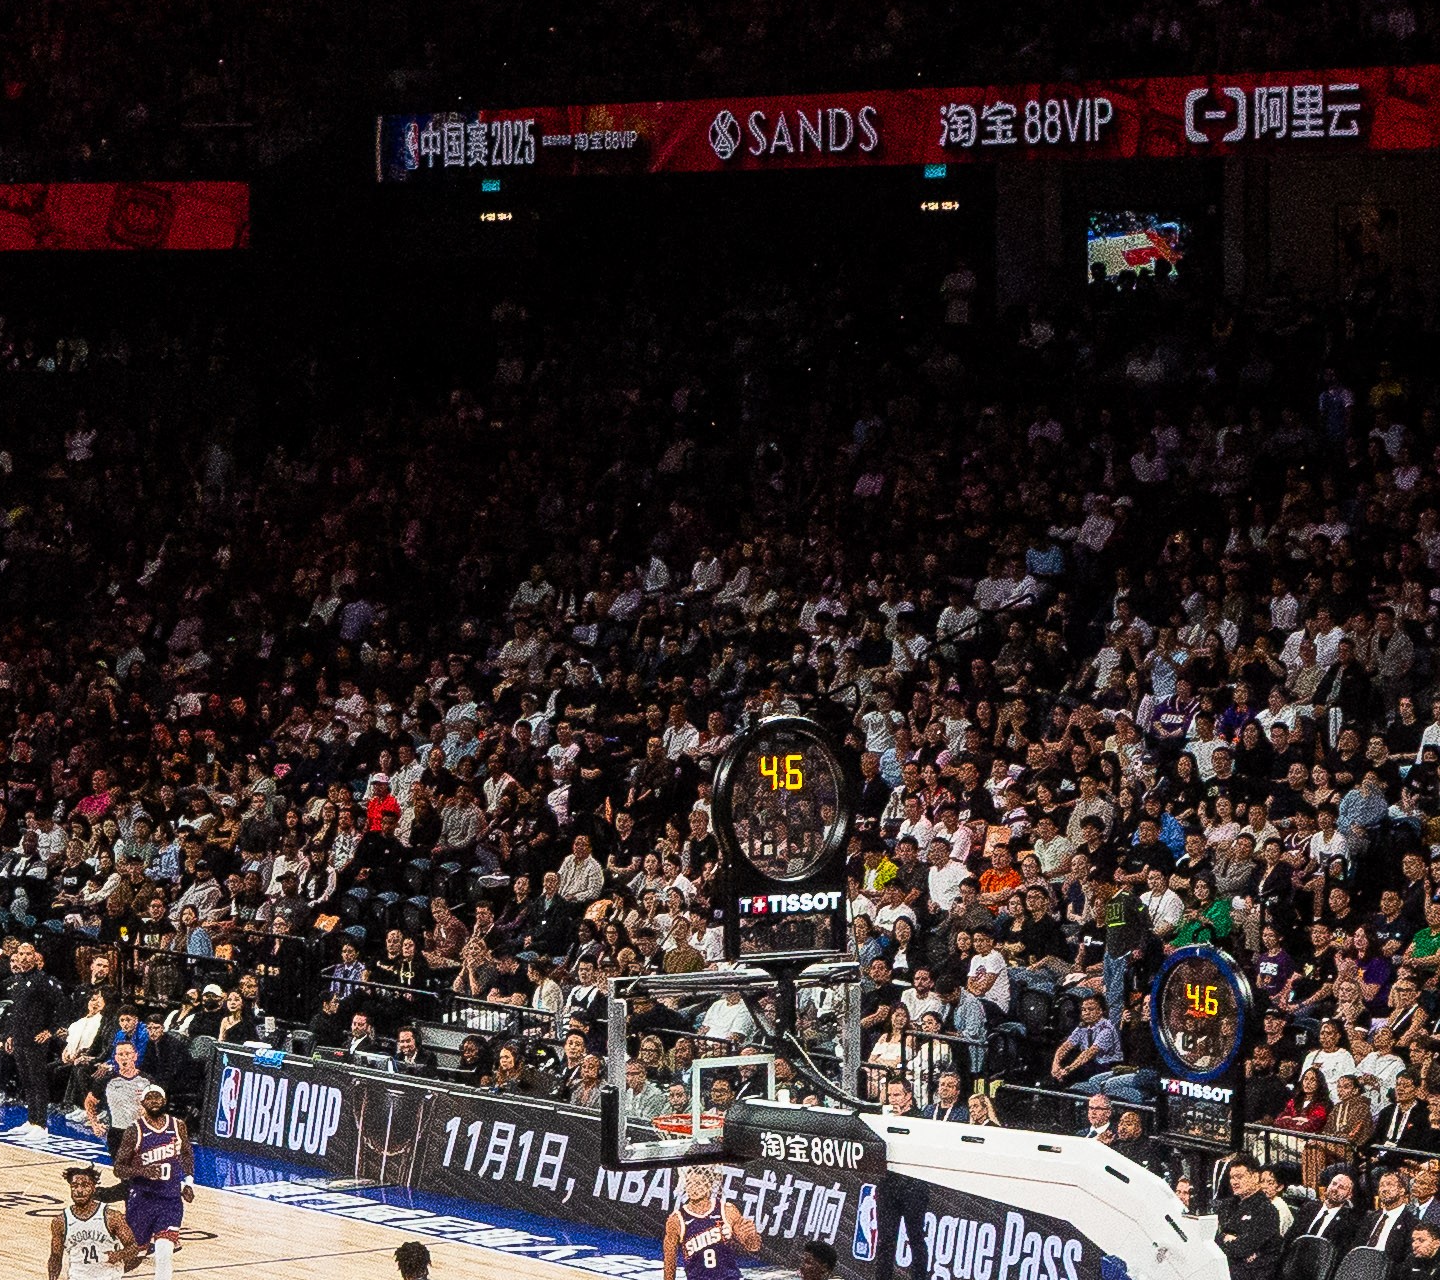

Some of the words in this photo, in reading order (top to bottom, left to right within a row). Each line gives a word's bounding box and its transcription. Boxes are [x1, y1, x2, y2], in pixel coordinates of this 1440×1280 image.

[939, 97, 1113, 147] 淘宝88VIP
[1253, 83, 1361, 140] 阿里云
[749, 106, 878, 155] SANDS
[760, 755, 803, 790] 4.6
[768, 892, 841, 914] TISSOT
[1187, 985, 1218, 1015] 4.6
[1180, 1083, 1232, 1103] TISSOT
[236, 1071, 288, 1148] NBA
[288, 1081, 342, 1156] CUP
[141, 1142, 181, 1165] SUNS
[760, 1132, 864, 1170] 淘宝88VIP
[81, 1245, 99, 1264] 24
[685, 1228, 732, 1258] SUNS
[704, 1249, 717, 1269] 8
